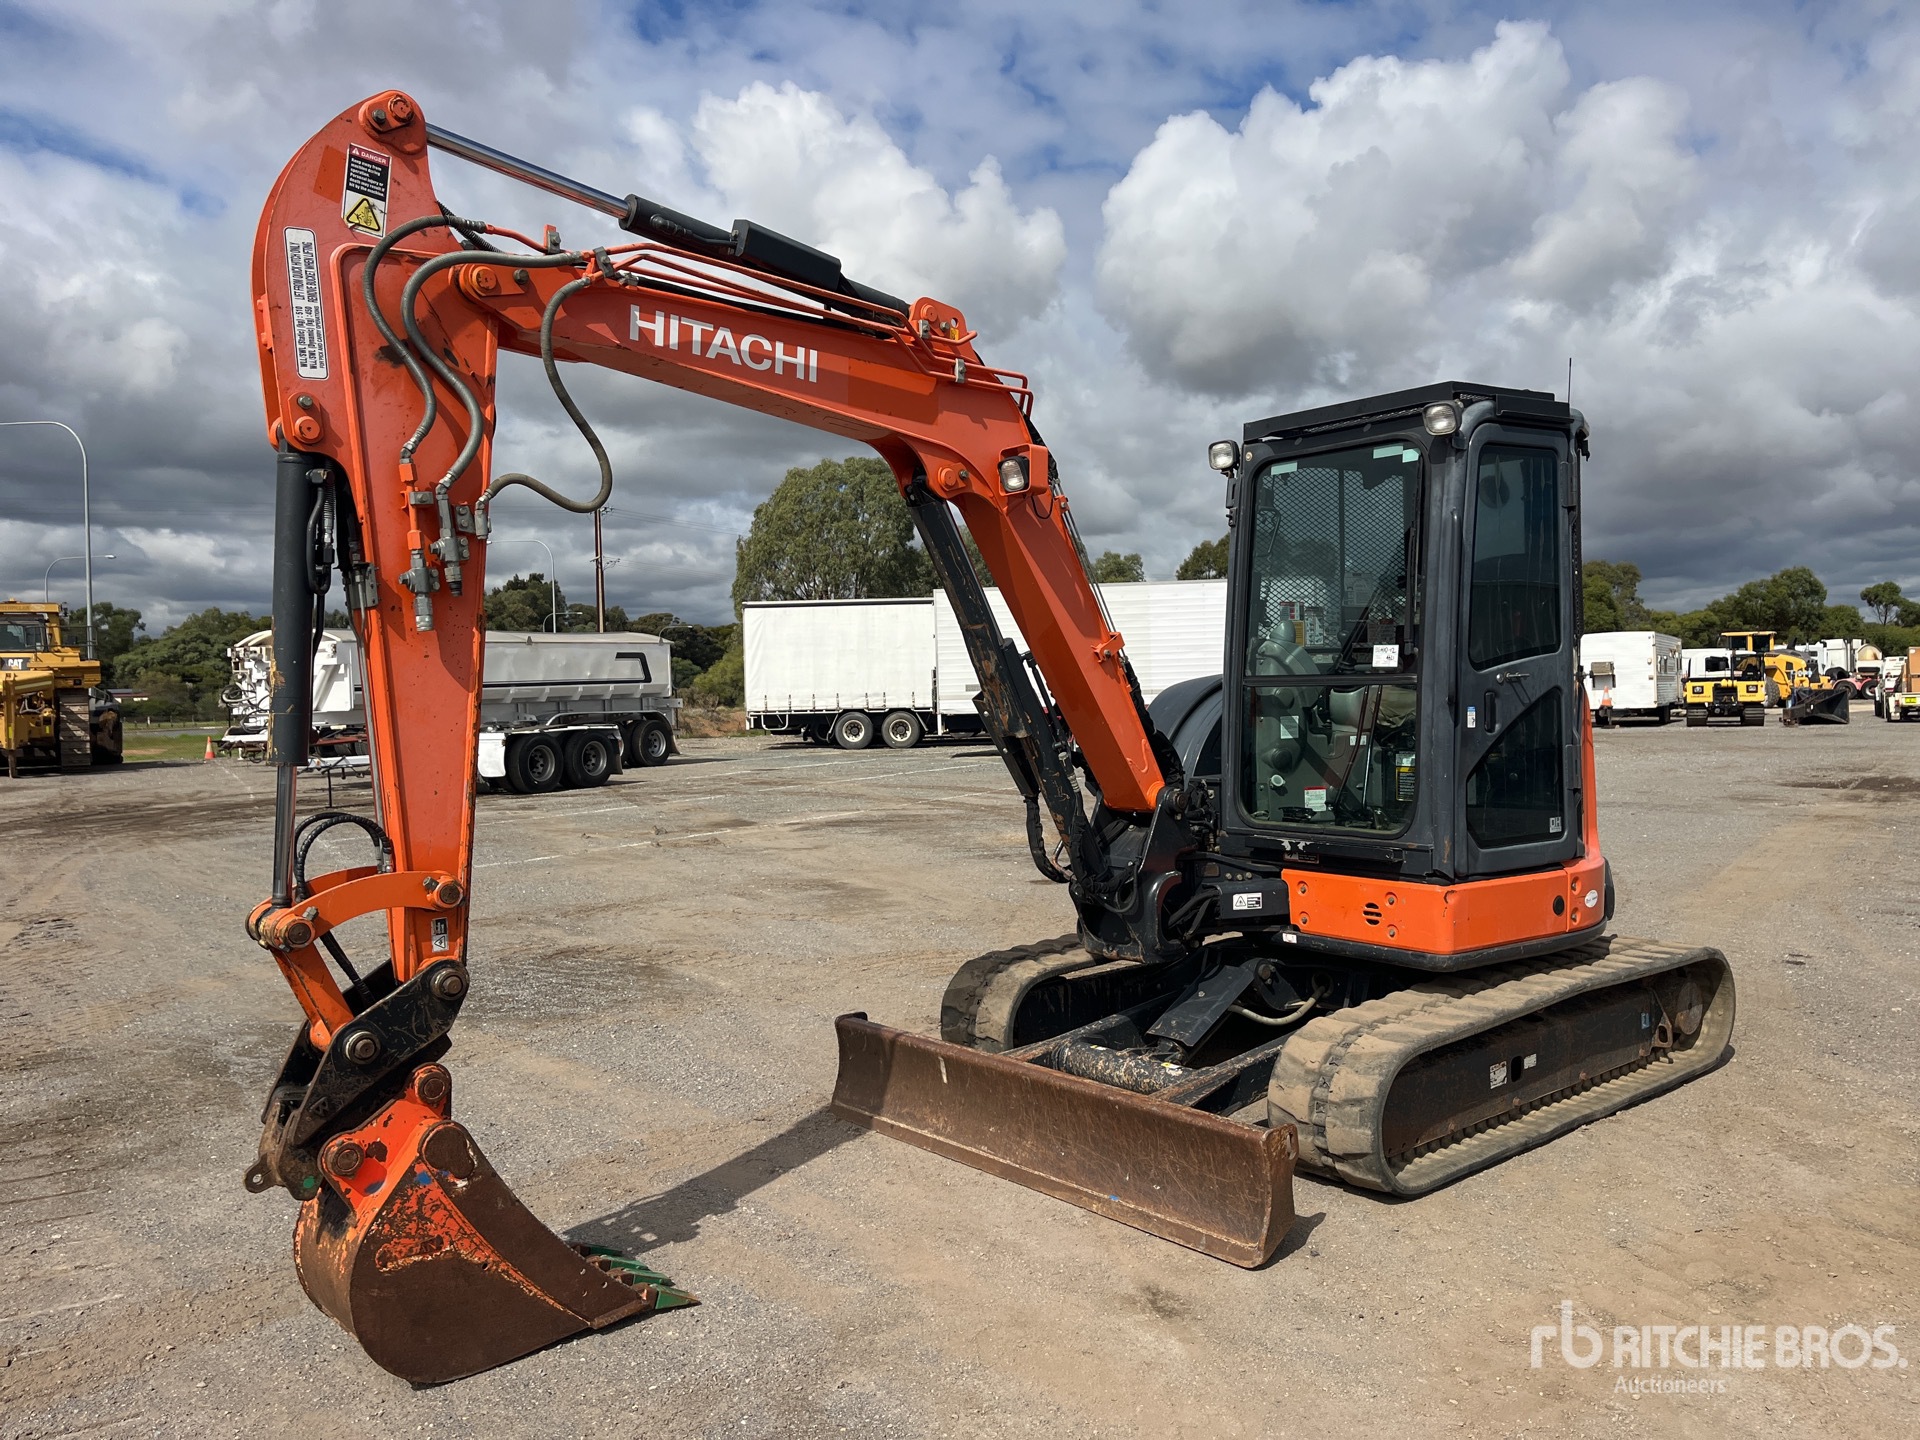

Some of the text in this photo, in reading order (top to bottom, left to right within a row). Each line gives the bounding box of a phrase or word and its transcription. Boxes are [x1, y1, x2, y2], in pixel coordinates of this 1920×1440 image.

[361, 151, 387, 164] DANGER
[289, 242, 305, 300] LIFT FROM QUICK HITCH ONLY
[302, 242, 318, 303] REMOVE BUCKET WHEN LIFTING
[296, 319, 305, 328] (kg)
[305, 318, 315, 327] (kg)
[297, 329, 307, 346] (Static)
[306, 328, 317, 349] (Dynamic)
[629, 304, 818, 383] HITACHI
[299, 347, 308, 367] WLL/SWL
[308, 350, 317, 369] WLL/SWL
[8, 659, 23, 670] CAT
